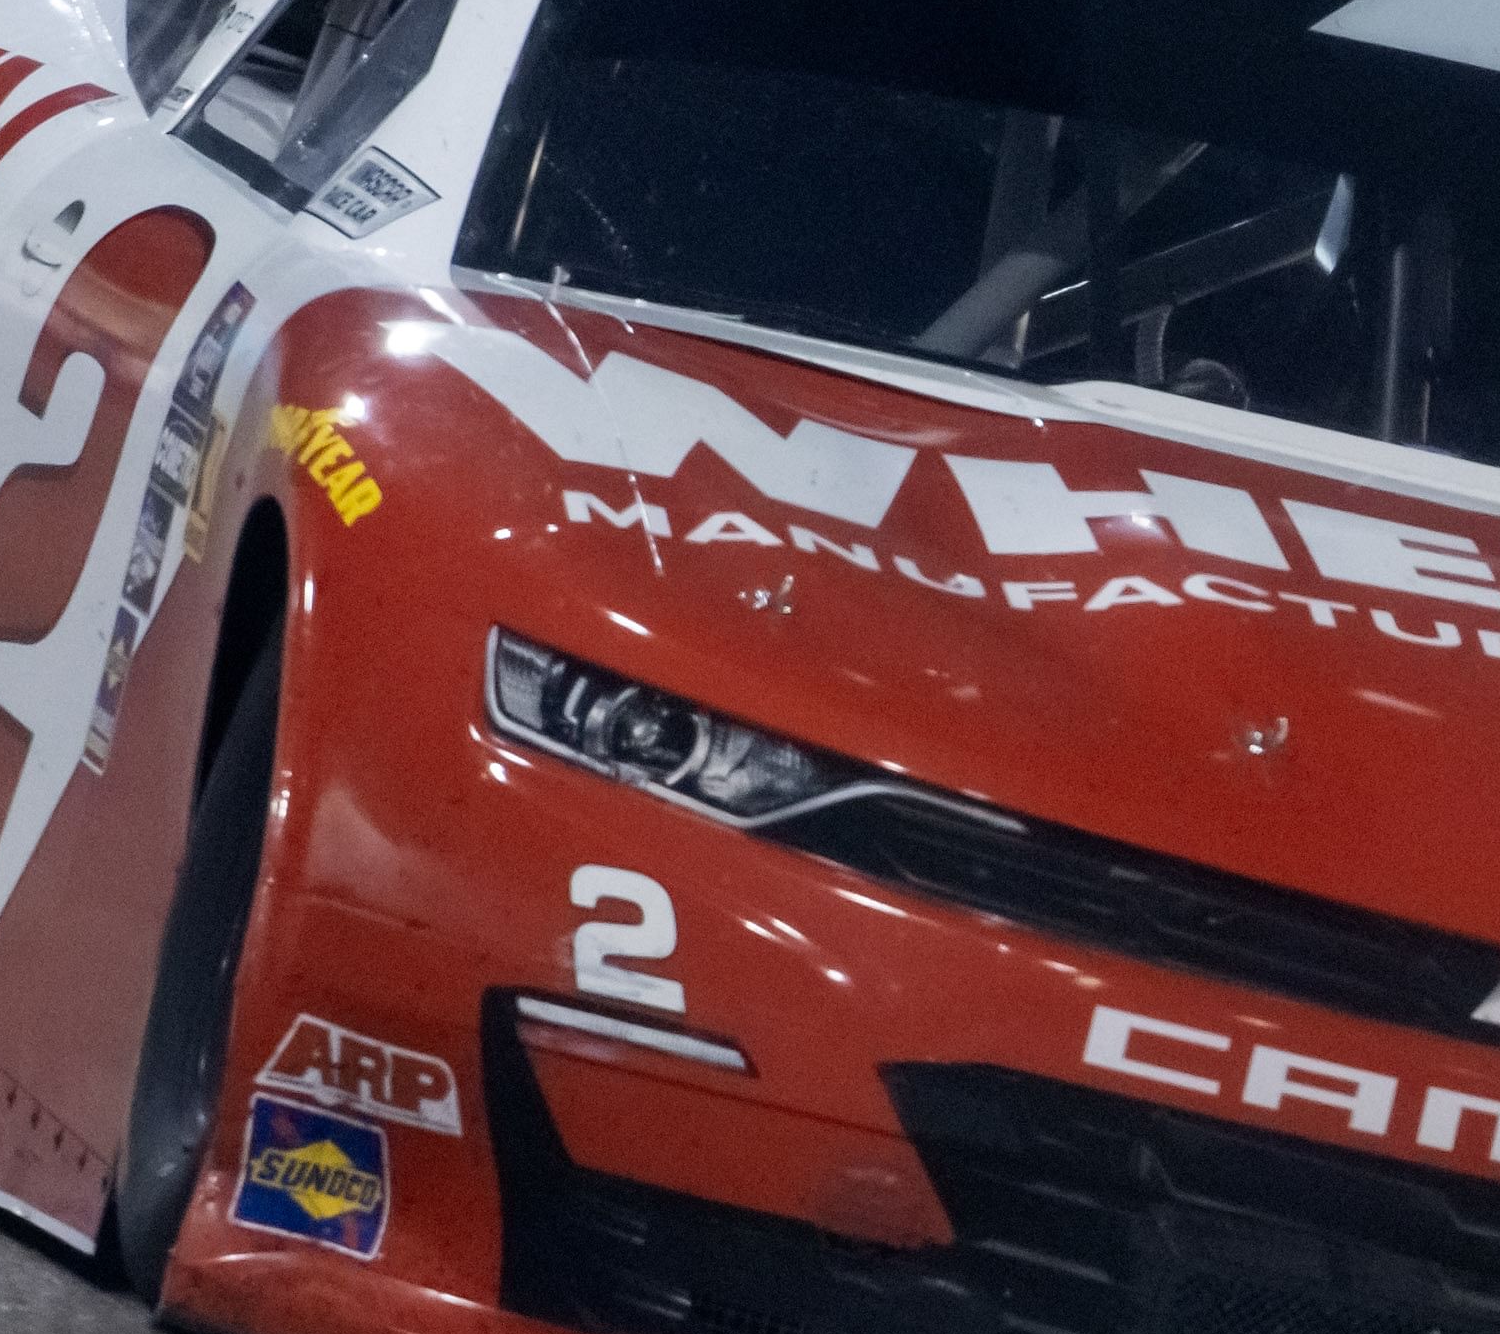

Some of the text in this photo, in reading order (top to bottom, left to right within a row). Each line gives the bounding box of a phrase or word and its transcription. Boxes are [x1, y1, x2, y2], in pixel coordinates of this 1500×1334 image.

[270, 404, 384, 527] DYEAR
[569, 864, 686, 1014] 2
[260, 1015, 457, 1123] ARP
[255, 1150, 382, 1210] SUNOCO
